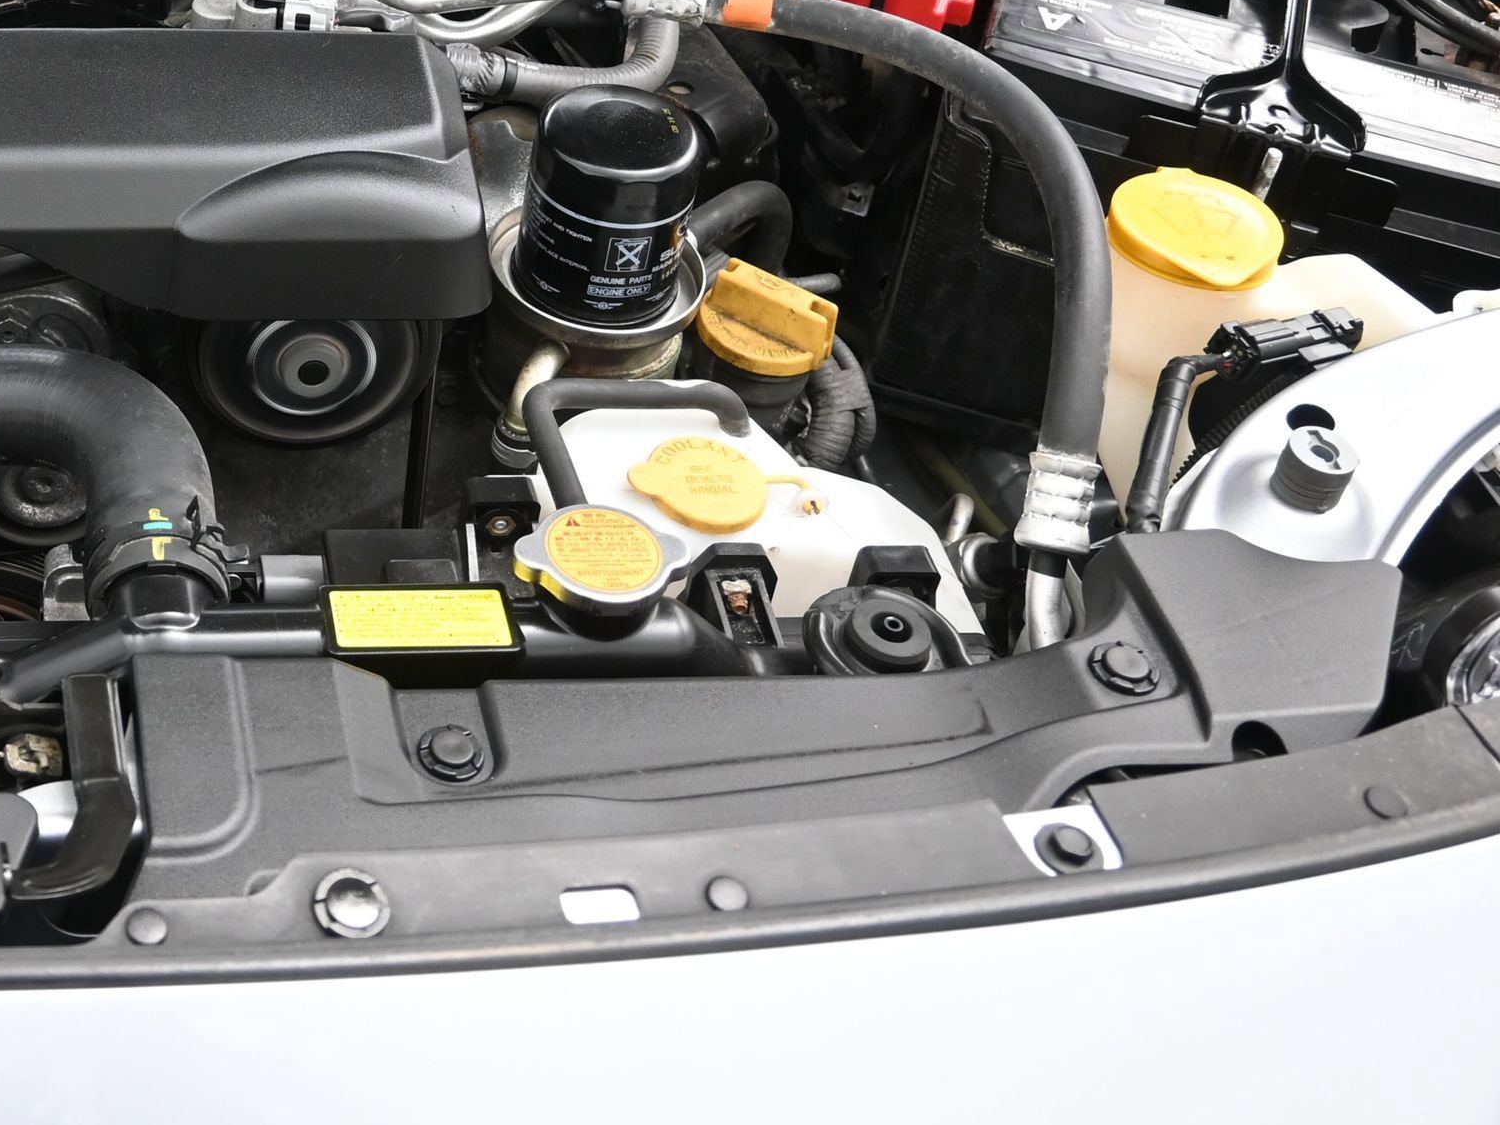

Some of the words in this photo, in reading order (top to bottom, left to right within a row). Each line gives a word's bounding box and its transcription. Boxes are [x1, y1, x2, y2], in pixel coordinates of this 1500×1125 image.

[590, 274, 627, 285] GENUINE
[628, 273, 653, 285] PARTS
[589, 286, 624, 297] ENGINE
[626, 284, 650, 296] ONLY
[655, 438, 748, 466] COOLANT
